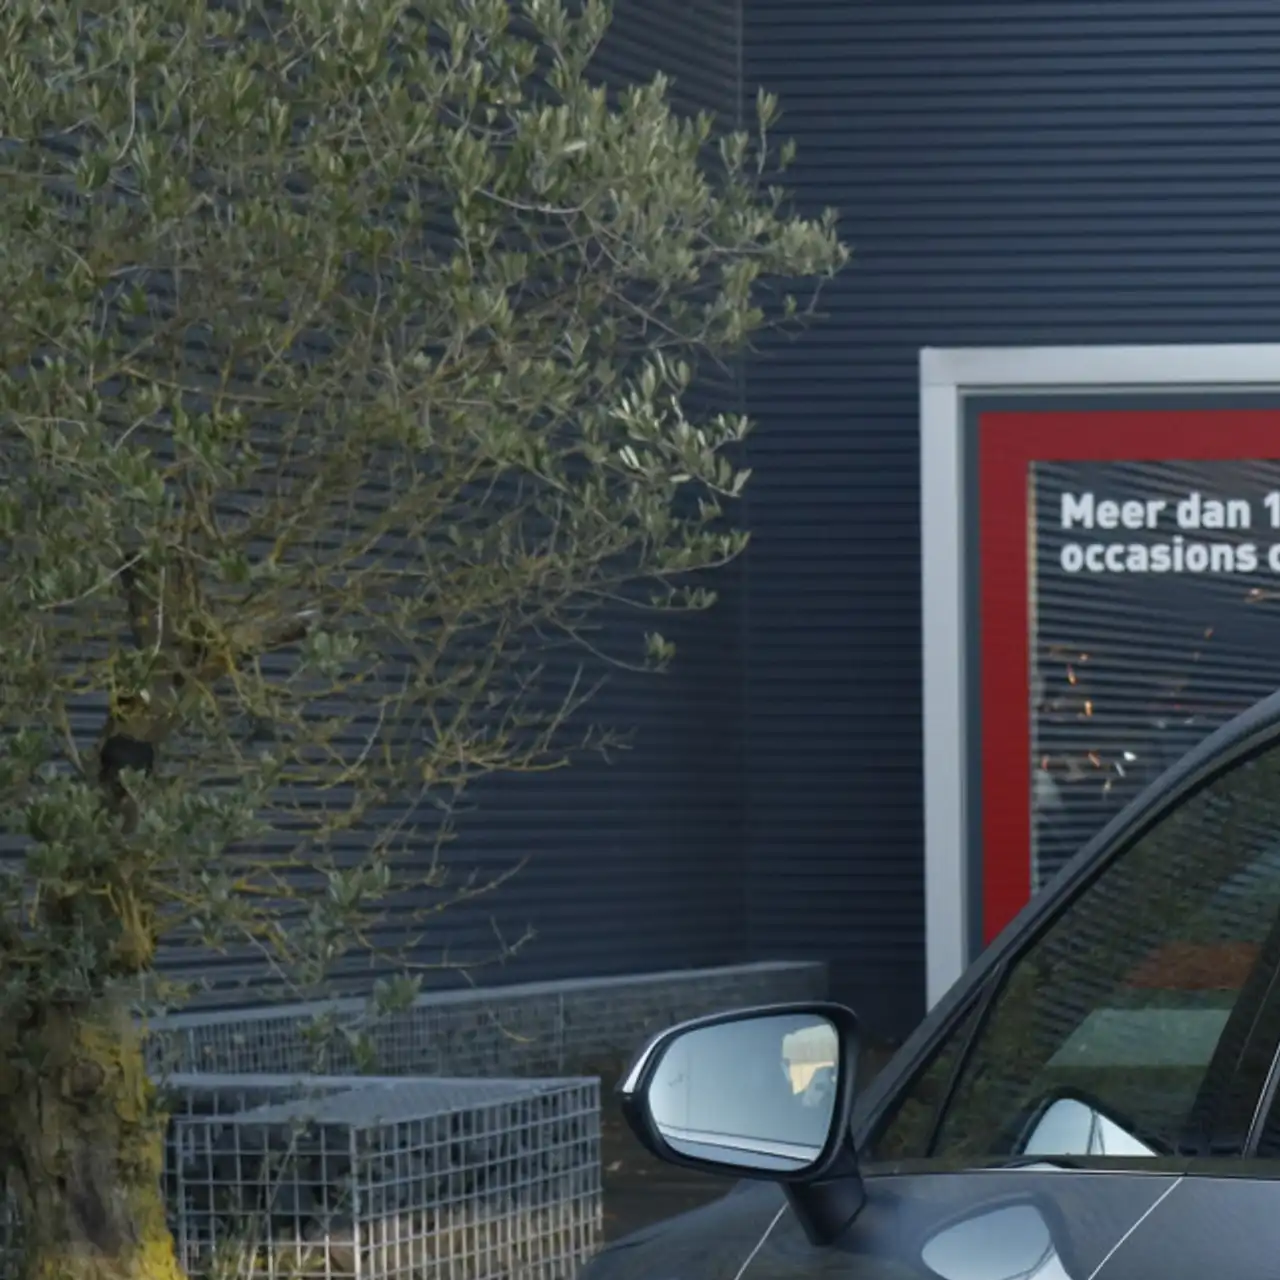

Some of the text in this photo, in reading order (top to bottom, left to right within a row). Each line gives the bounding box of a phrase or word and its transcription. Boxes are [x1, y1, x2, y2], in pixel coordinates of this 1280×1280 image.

[1061, 492, 1165, 528] Meer
[1177, 492, 1250, 528] dan
[1060, 536, 1257, 572] occasions
